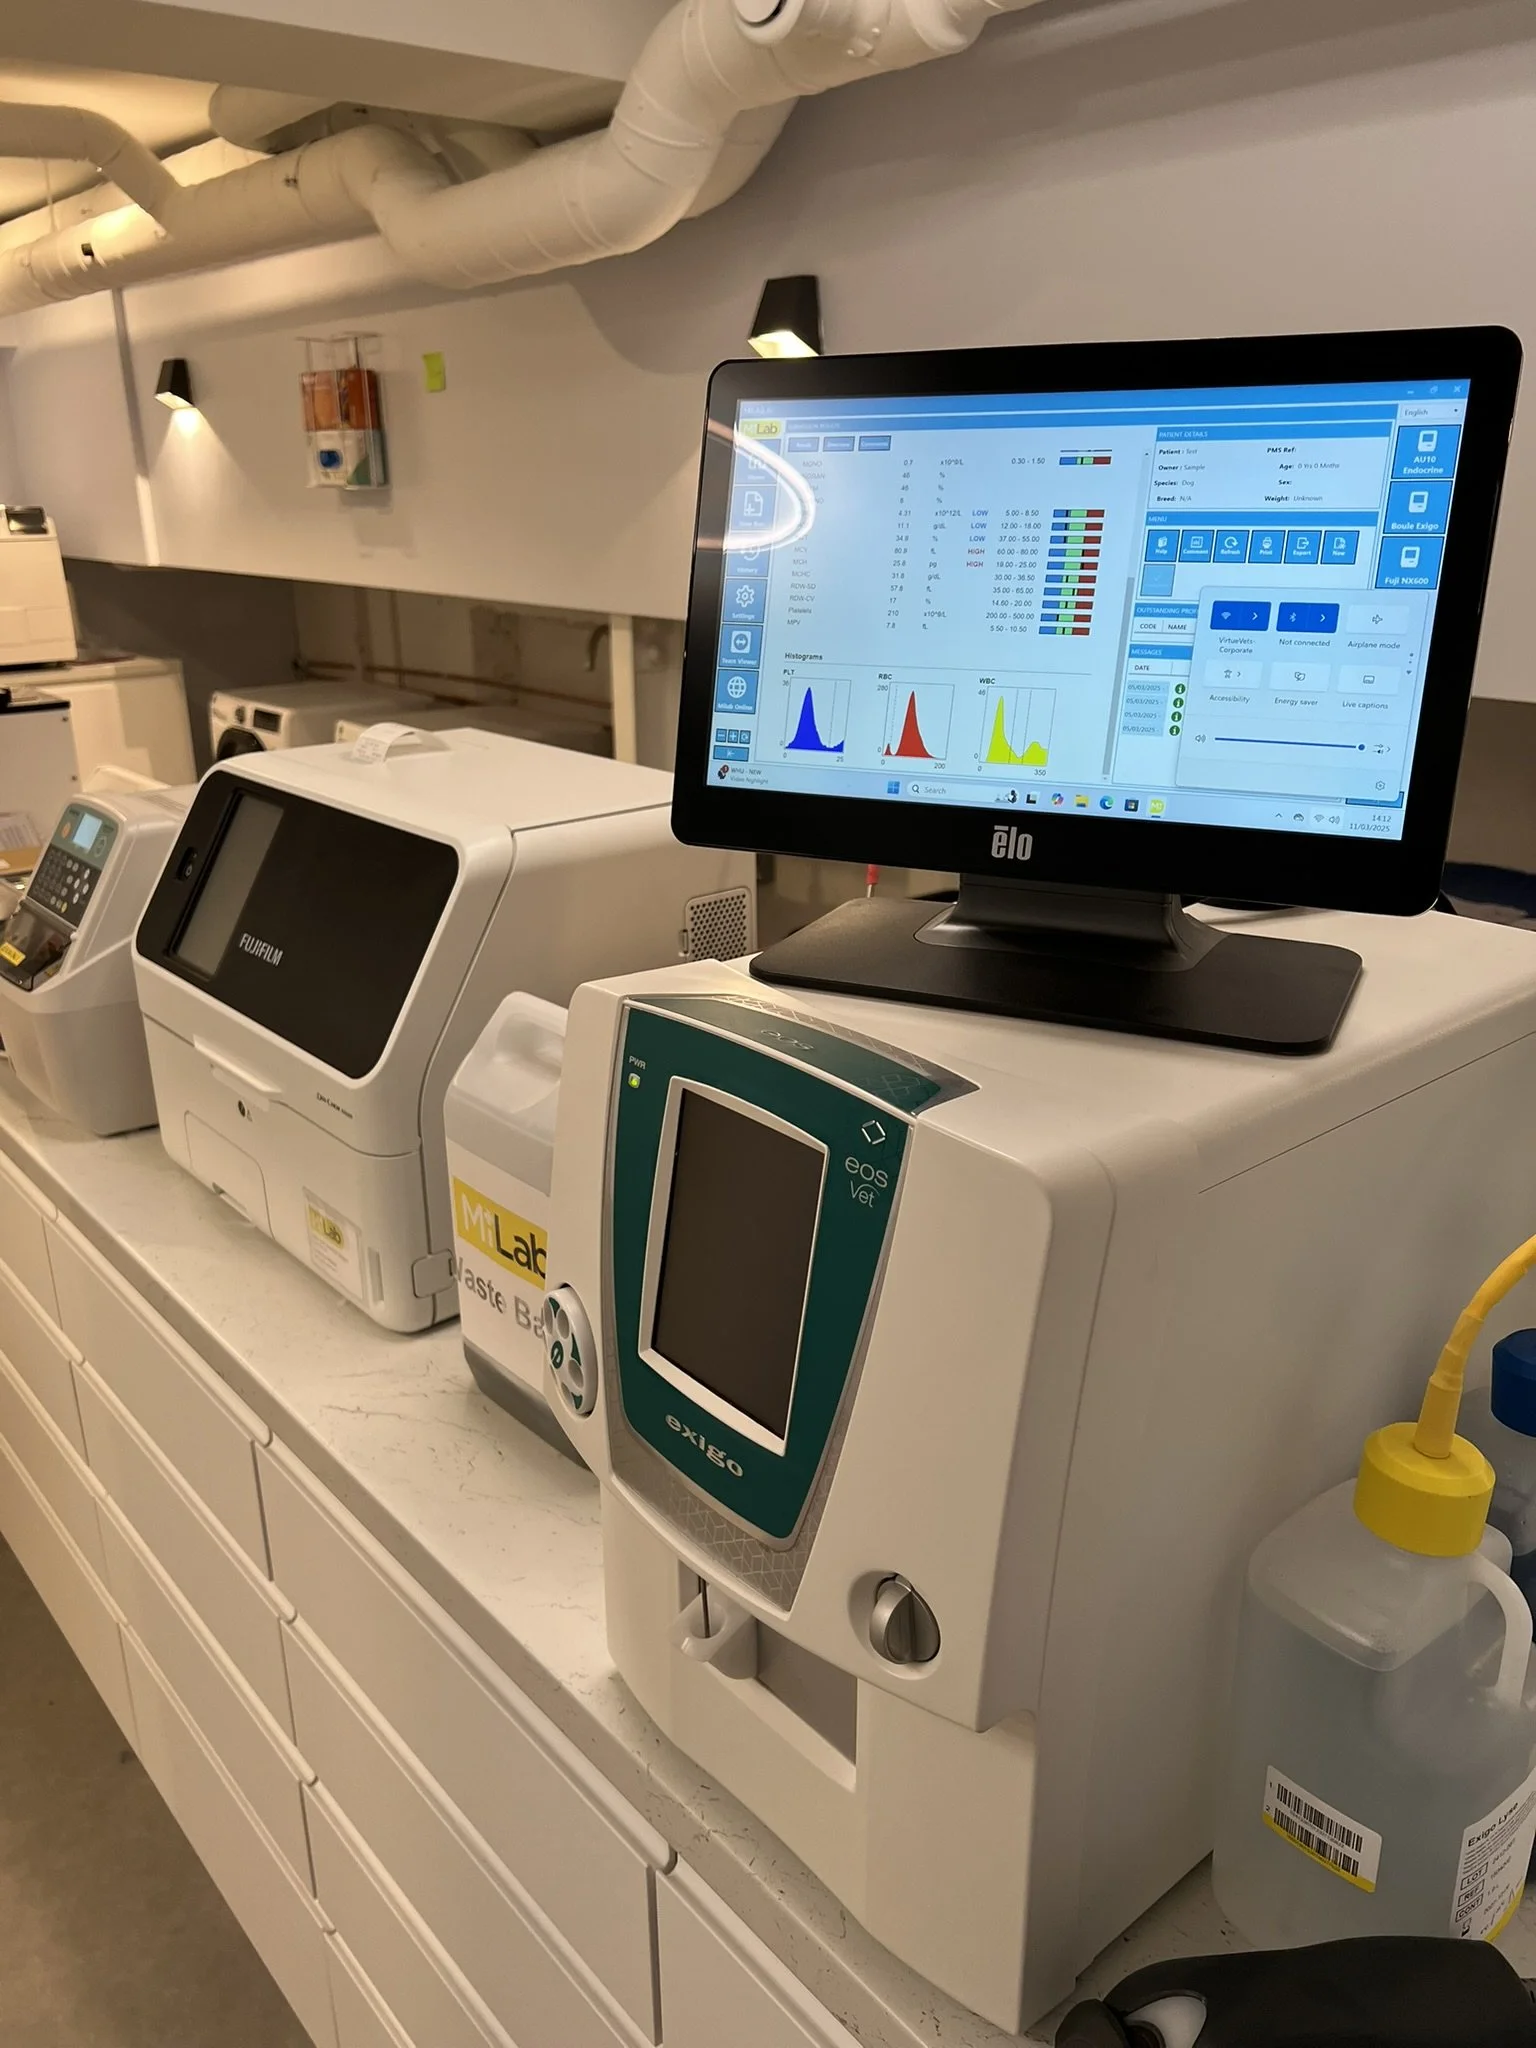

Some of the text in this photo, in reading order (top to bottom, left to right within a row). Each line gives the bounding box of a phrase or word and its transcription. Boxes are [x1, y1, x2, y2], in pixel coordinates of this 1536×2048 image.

[1405, 409, 1428, 417] English
[1011, 457, 1026, 465] 0.30
[1032, 457, 1045, 465] 1.50
[970, 522, 987, 530] LOW
[1001, 522, 1018, 530] 12.00
[1024, 522, 1041, 530] 18.00
[1416, 523, 1439, 531] Exigo
[1384, 577, 1429, 586] Fuji NX600
[732, 612, 755, 620] Settings
[985, 612, 1007, 620] 200.00
[1279, 638, 1331, 647] Not connected
[1347, 640, 1378, 649] Airplane
[1219, 646, 1253, 655] Corporate
[784, 652, 823, 661] Histograms
[737, 658, 758, 666] Viewer
[979, 677, 996, 685] WBC
[1209, 694, 1251, 704] Accessibility
[1274, 697, 1298, 707] Energy
[1342, 700, 1388, 710] Live captions
[934, 762, 946, 770] 200
[1034, 769, 1047, 777] 350
[923, 786, 946, 795] Search
[1349, 823, 1390, 832] 11/03/2025
[239, 932, 284, 967] FUJIFILM
[628, 1055, 647, 1070] PWR
[845, 1156, 889, 1188] eos
[461, 1191, 547, 1279] MiLab
[665, 1414, 744, 1477] exigo
[1467, 1802, 1519, 1848] Exigo Lyse
[1466, 1870, 1483, 1886] LOT
[1463, 1886, 1480, 1901] REF
[1458, 1899, 1481, 1918] CONT
